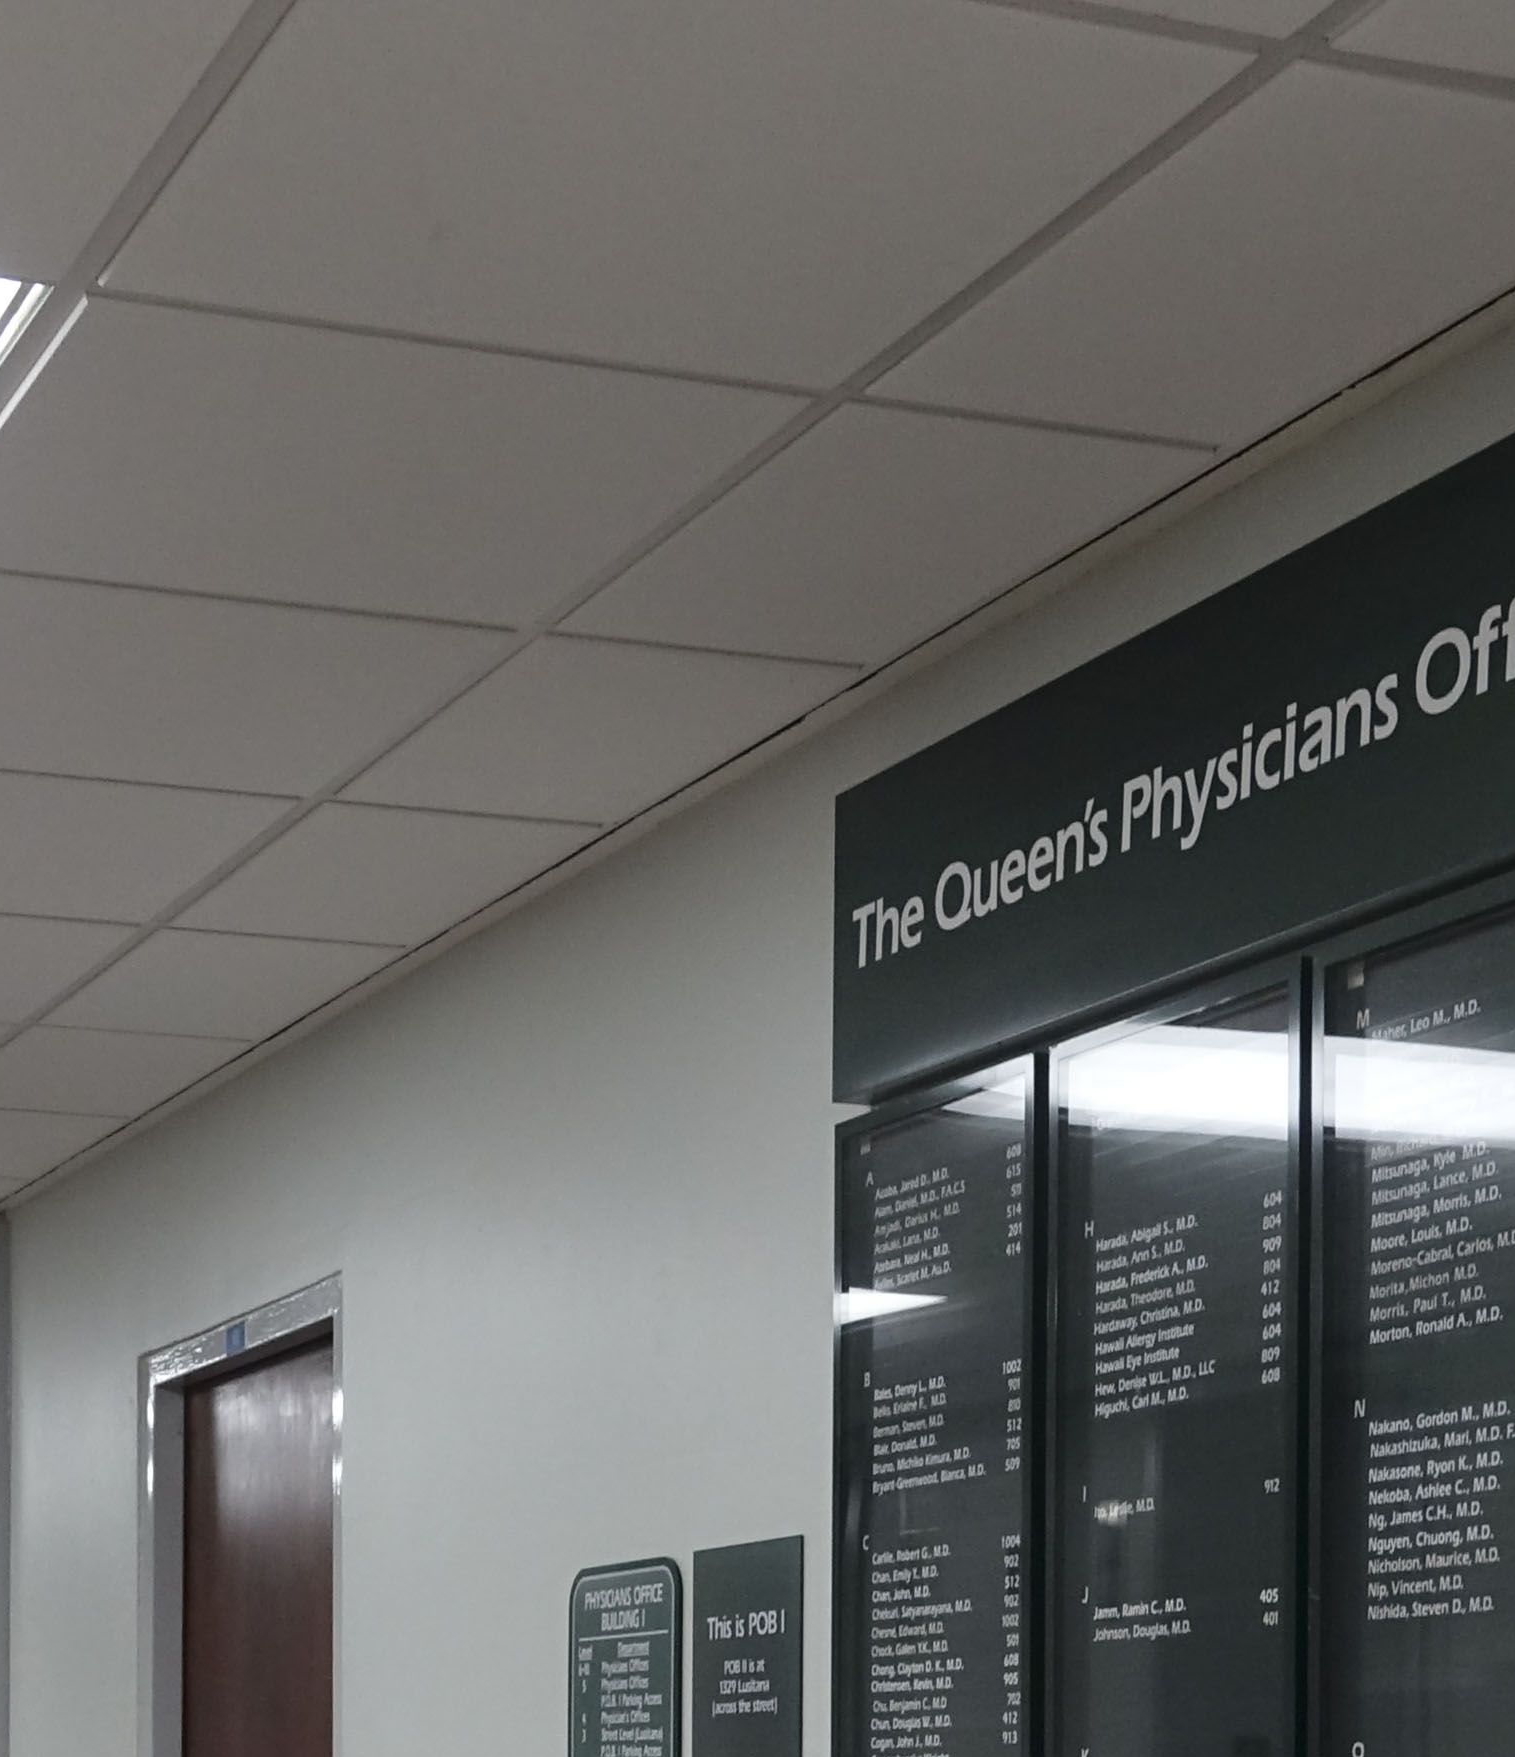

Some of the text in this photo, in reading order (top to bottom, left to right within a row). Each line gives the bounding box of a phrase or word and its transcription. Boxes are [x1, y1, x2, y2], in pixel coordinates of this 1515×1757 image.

[852, 896, 924, 968] The
[935, 798, 1107, 930] Queen's
[1120, 673, 1397, 852] Physicians
[1126, 1354, 1141, 1371] Eye
[1143, 1347, 1179, 1365] Institute
[1262, 1322, 1281, 1340] 604
[1354, 1399, 1366, 1418] N
[1369, 1418, 1413, 1436] Nakano,
[1416, 1410, 1458, 1428] Gordon
[1461, 1405, 1479, 1421] M.,
[1482, 1400, 1510, 1419] M.D.
[585, 1583, 663, 1610] PHYSICIANS OFFICE
[601, 1610, 639, 1631] BUILDING
[707, 1616, 732, 1641] This
[735, 1615, 745, 1637] is
[749, 1610, 777, 1636] POB
[724, 1660, 740, 1675] POB
[748, 1659, 755, 1673] is
[756, 1658, 765, 1672] at
[601, 1678, 628, 1693] Physicians
[738, 1699, 751, 1713] the
